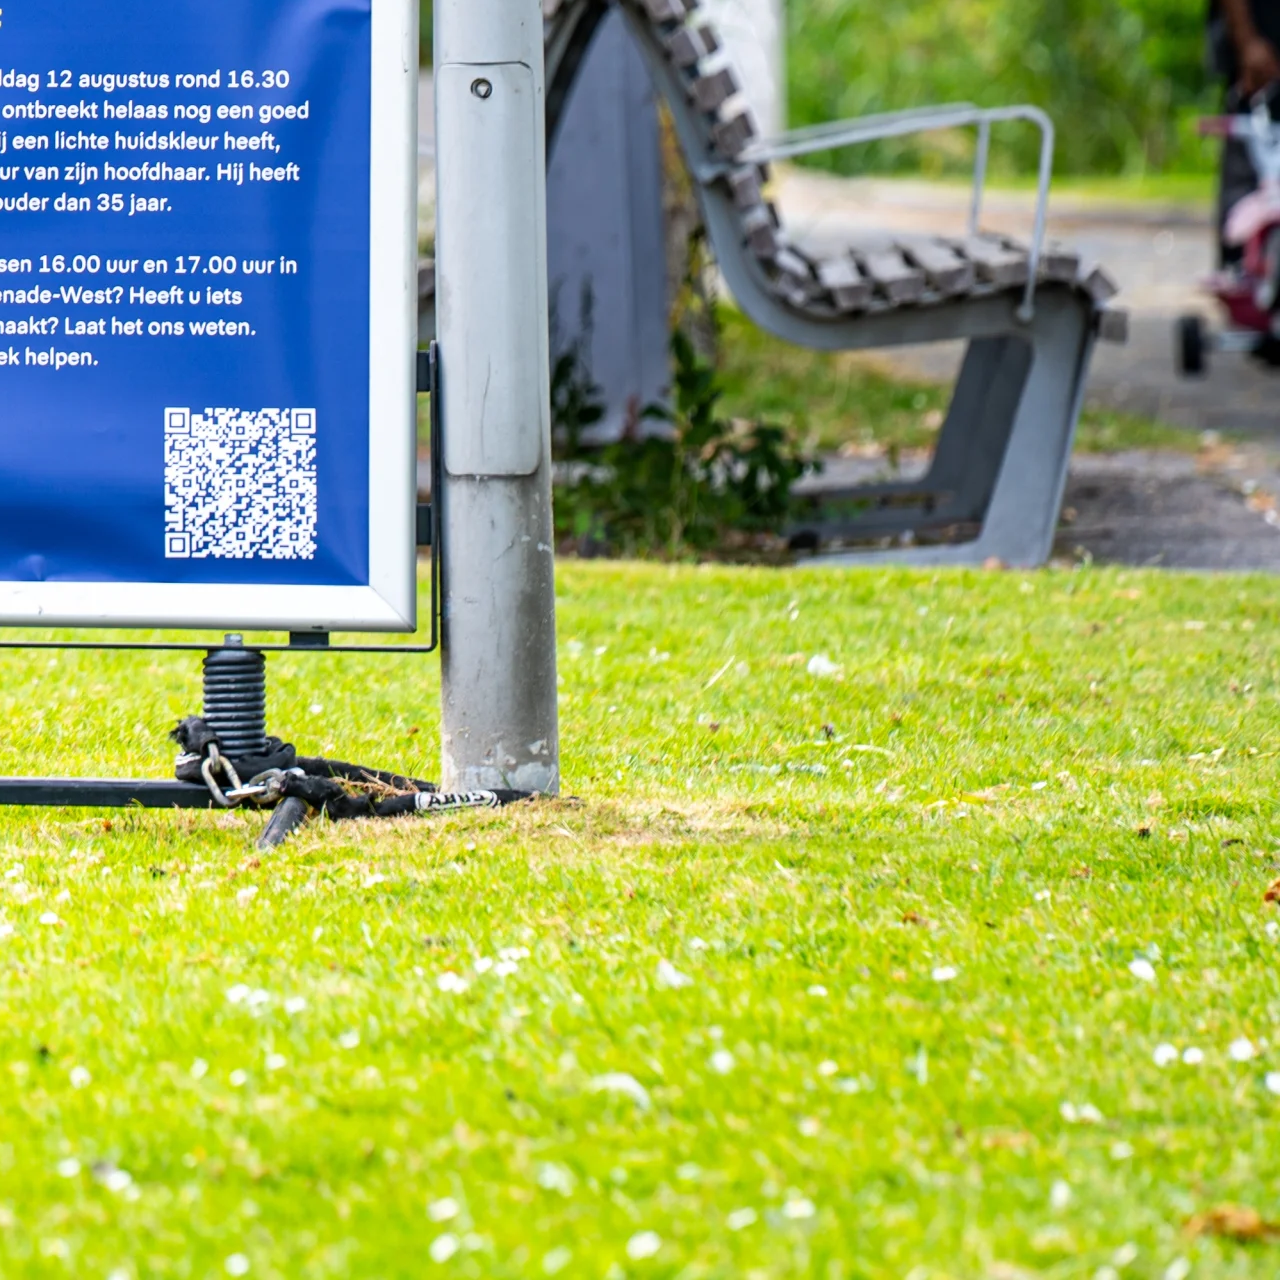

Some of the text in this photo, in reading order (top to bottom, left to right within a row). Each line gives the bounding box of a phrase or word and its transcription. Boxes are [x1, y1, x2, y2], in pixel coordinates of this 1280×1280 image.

[46, 69, 73, 89] 12
[78, 70, 171, 93] augustus
[175, 68, 221, 89] rond
[227, 69, 291, 89] 16.30
[1, 99, 99, 120] ontbreekt
[103, 99, 169, 120] helaas
[173, 104, 212, 124] nog
[216, 104, 255, 120] een
[258, 99, 310, 125] goed
[11, 135, 50, 150] een
[54, 130, 110, 151] lichte
[114, 130, 220, 151] huidskleur
[223, 130, 281, 154] heeft,
[23, 165, 60, 181] van
[63, 161, 99, 186] zijn
[103, 161, 211, 182] hoofdhaar.
[216, 162, 244, 186] Hij
[249, 161, 301, 182] heeft
[53, 191, 92, 212] dan
[96, 192, 125, 213] 35
[127, 192, 173, 217] jaar.
[38, 254, 101, 274] 16.00
[105, 259, 140, 274] uur
[142, 259, 169, 274] en
[174, 255, 238, 275] 17.00
[241, 259, 276, 275] uur
[279, 255, 298, 275] in
[129, 284, 185, 306] Heeft
[188, 290, 201, 306] u
[206, 286, 244, 306] iets
[64, 316, 107, 336] Laat
[111, 315, 144, 336] het
[147, 320, 185, 337] ons
[188, 318, 257, 337] weten.
[24, 346, 99, 371] helpen.
